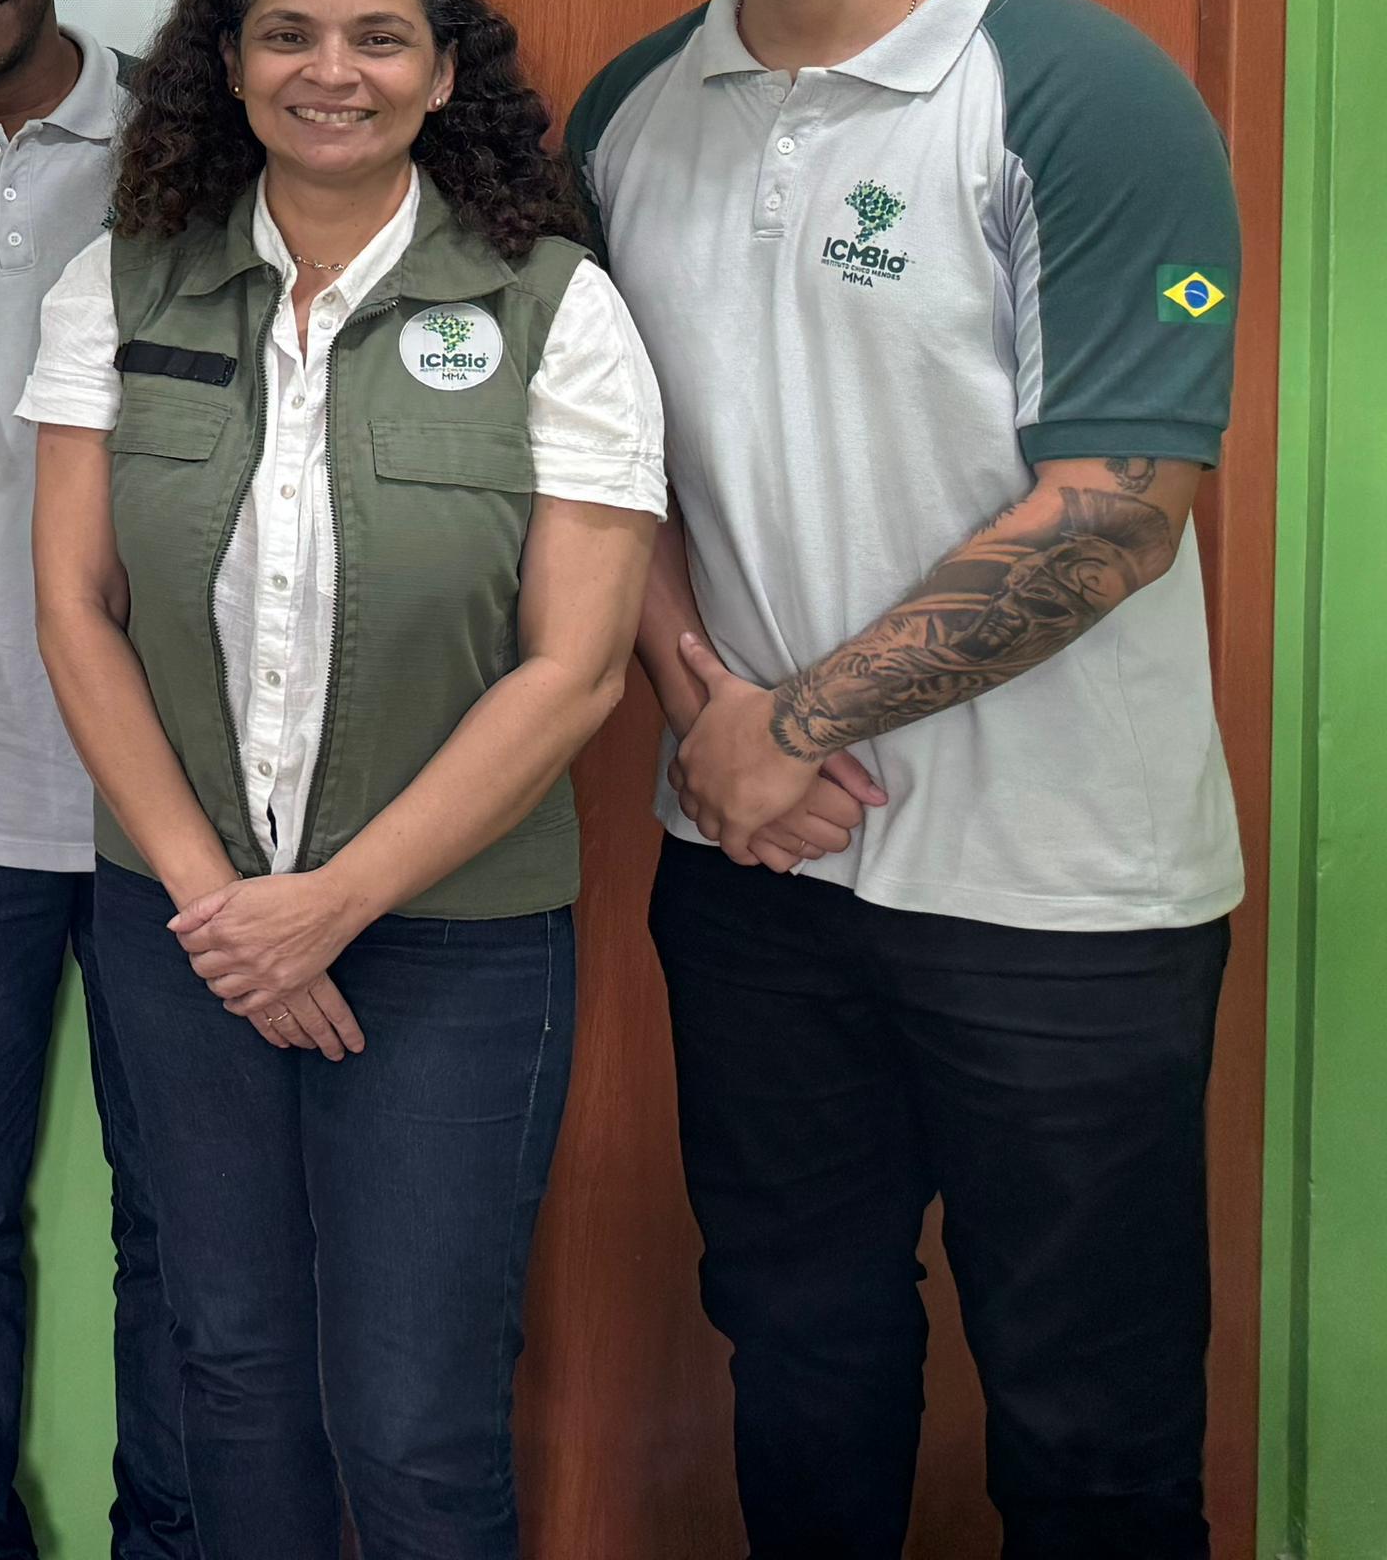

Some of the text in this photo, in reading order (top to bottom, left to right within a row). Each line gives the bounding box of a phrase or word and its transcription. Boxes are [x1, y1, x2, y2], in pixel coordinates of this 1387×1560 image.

[822, 236, 906, 274] ICMBio
[842, 271, 873, 288] MMA
[420, 353, 487, 368] ICMBio
[442, 372, 467, 380] MMA
